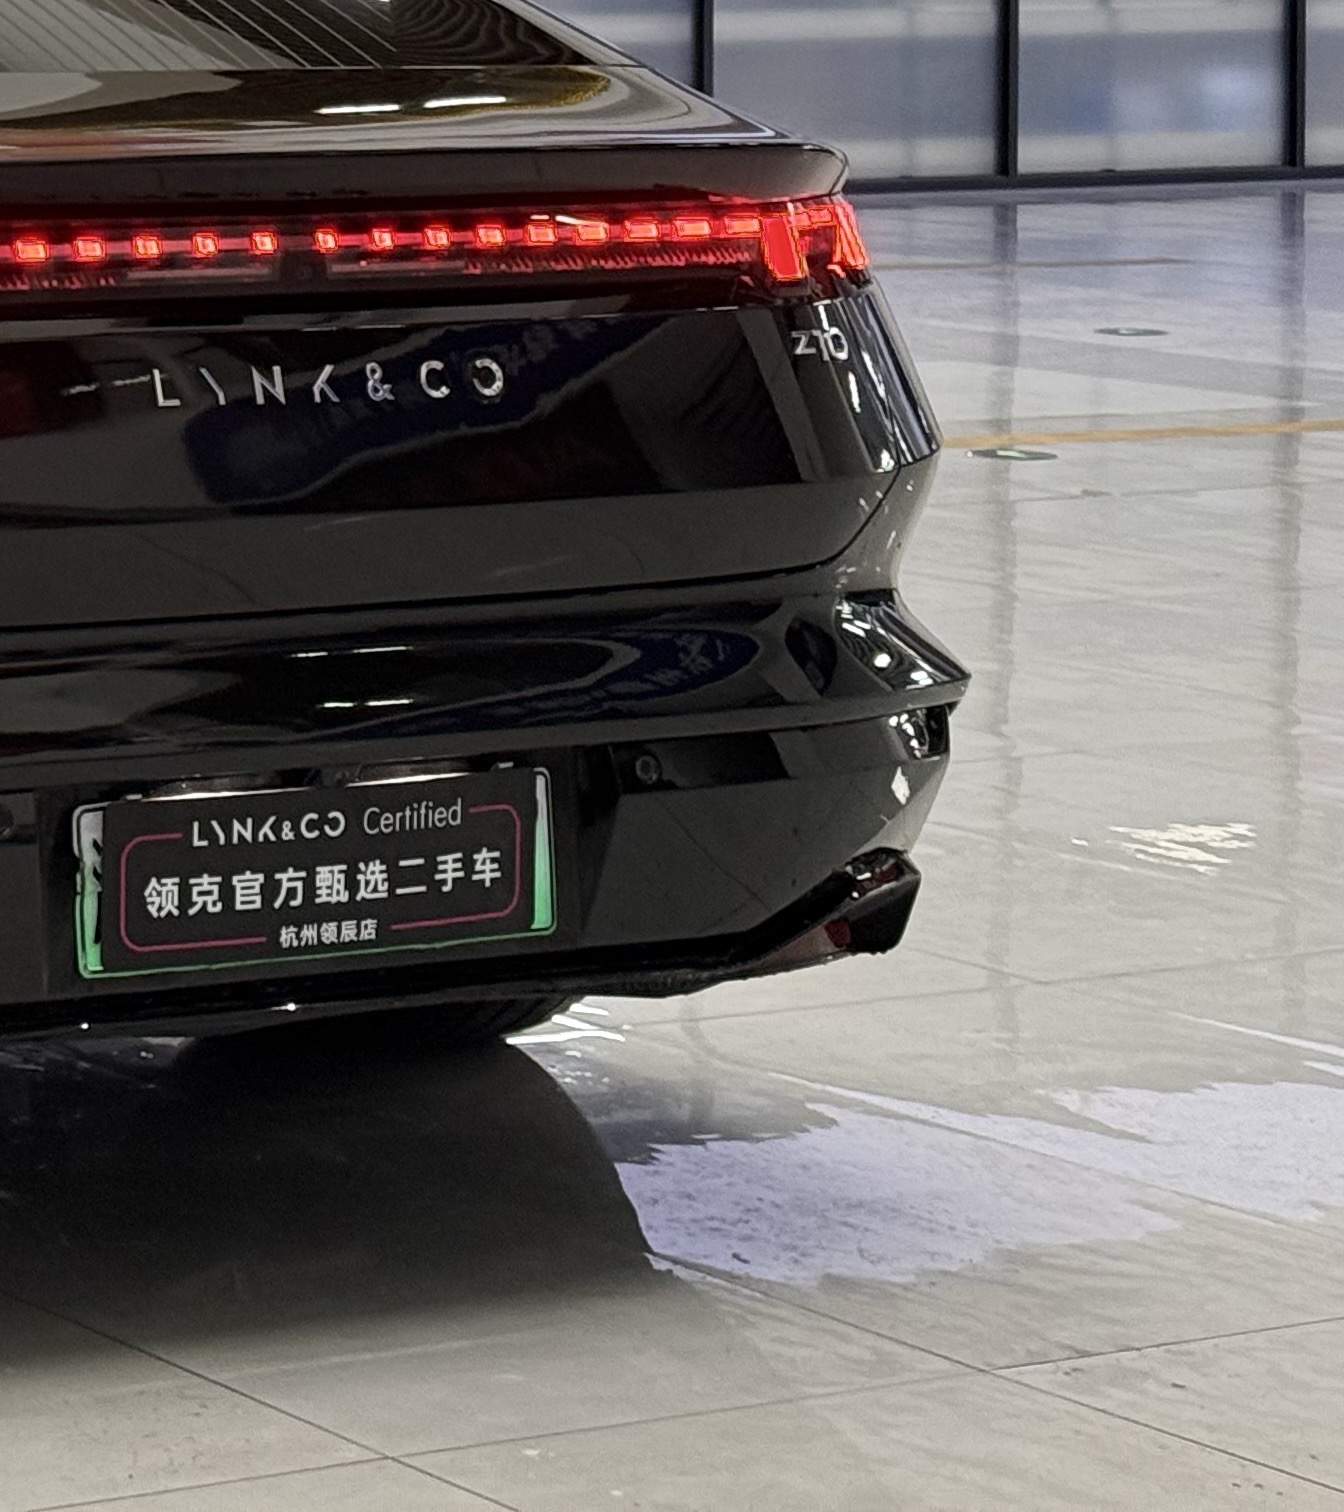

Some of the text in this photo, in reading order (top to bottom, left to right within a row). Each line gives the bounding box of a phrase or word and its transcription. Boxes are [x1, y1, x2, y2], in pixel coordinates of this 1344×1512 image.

[192, 797, 463, 848] LYNK&CO Certified
[143, 846, 502, 920] 领克官方甄选二手车
[279, 918, 379, 949] 杭州领辰店
